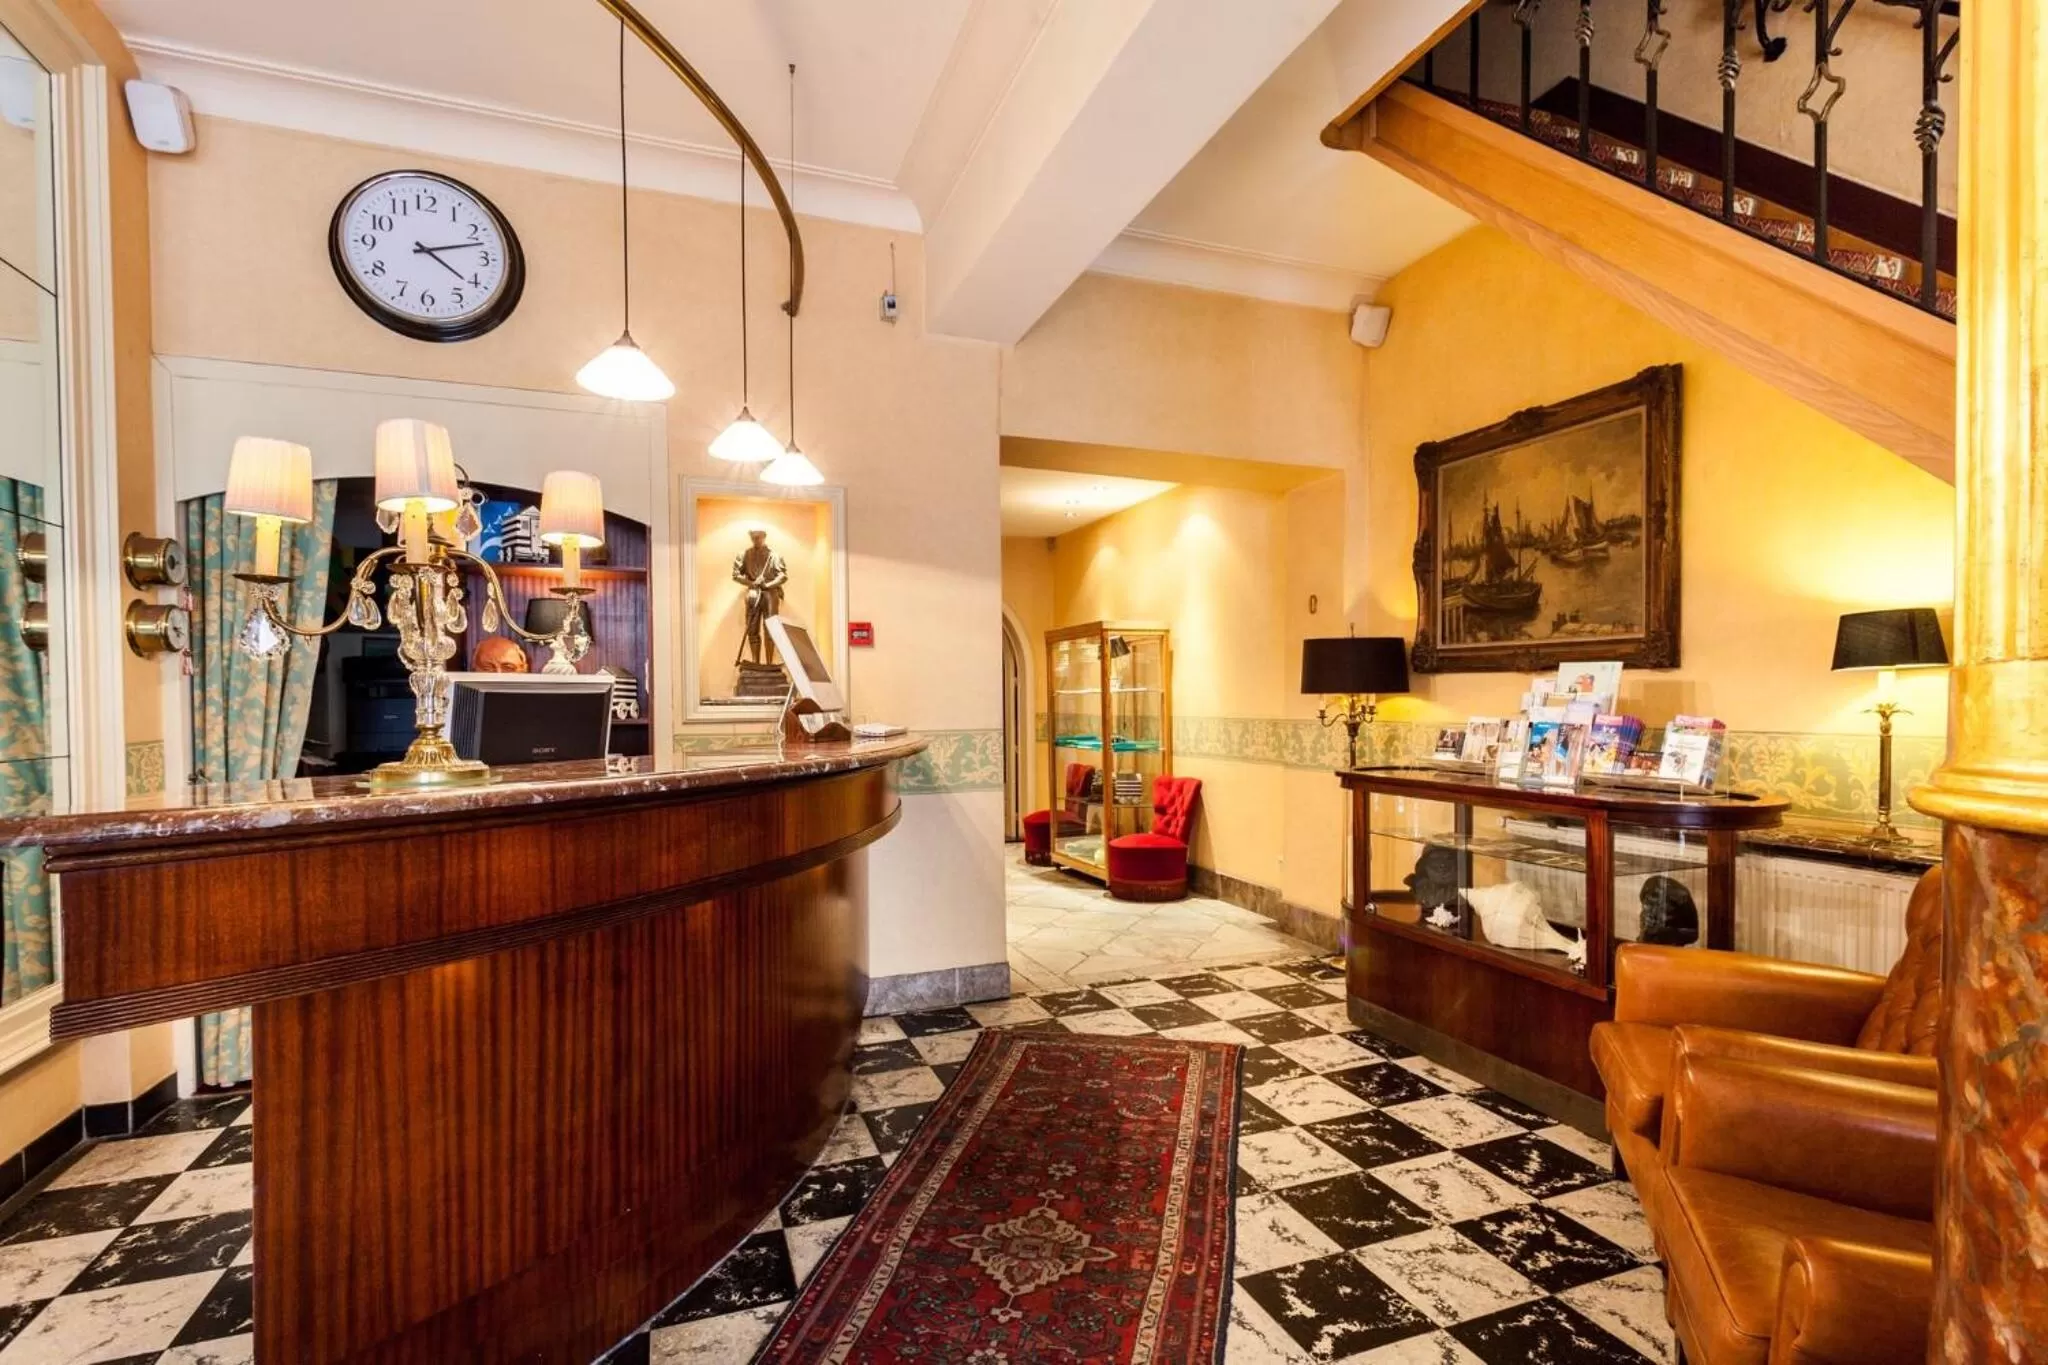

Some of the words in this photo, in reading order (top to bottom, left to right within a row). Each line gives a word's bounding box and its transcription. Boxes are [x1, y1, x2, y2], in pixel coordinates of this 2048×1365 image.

[392, 198, 407, 216] 11
[416, 194, 437, 213] 12
[372, 214, 393, 232] 10
[452, 206, 457, 223] 1
[467, 223, 480, 242] 2
[361, 233, 376, 251] 9
[478, 250, 490, 267] 3
[372, 260, 386, 277] 8
[396, 279, 409, 298] 7
[467, 272, 481, 289] 4
[420, 289, 435, 307] 6
[451, 287, 464, 304] 5
